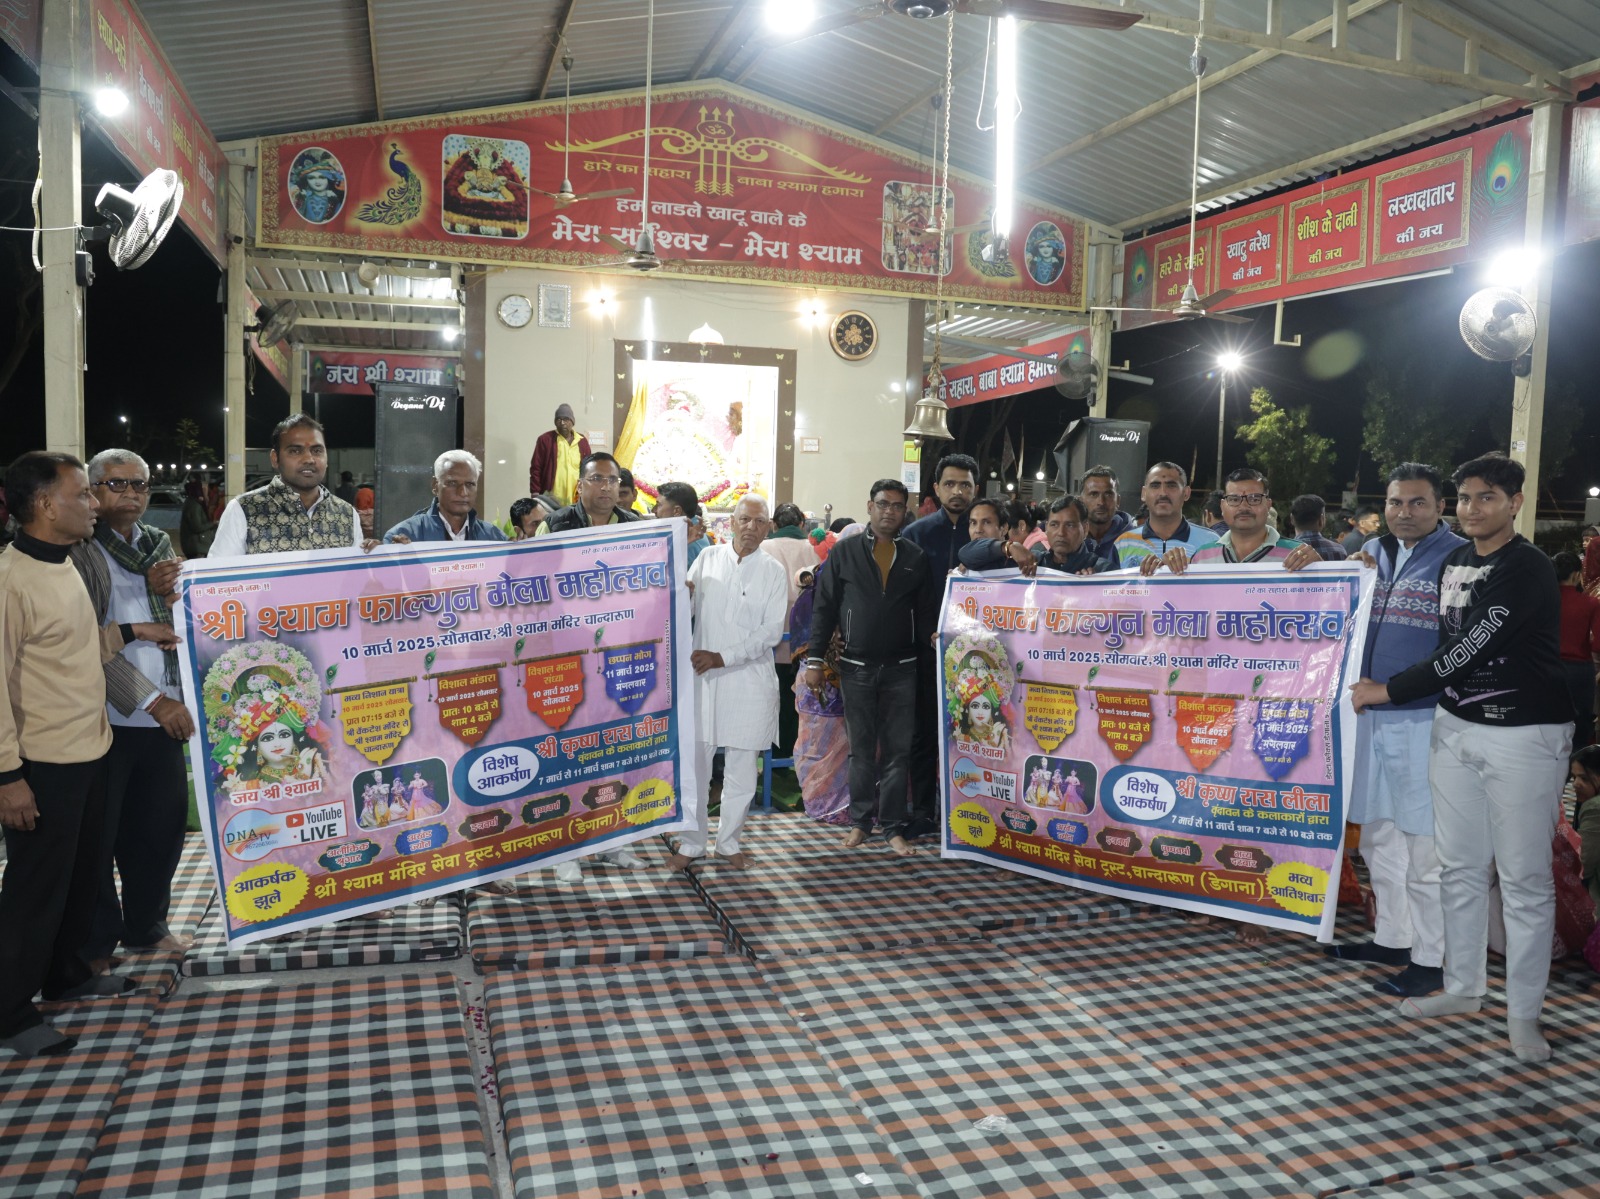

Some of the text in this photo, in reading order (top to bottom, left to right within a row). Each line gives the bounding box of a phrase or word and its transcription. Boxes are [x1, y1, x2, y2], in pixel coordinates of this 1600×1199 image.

[584, 160, 612, 172] हारे
[616, 163, 638, 175] का
[737, 176, 773, 188] बाबा
[777, 180, 818, 194] श्याम
[821, 184, 864, 198] हमारा
[1388, 181, 1456, 217] लखदातार
[616, 198, 807, 228] हम लाडले खाटू वाले के
[1297, 202, 1358, 240] शीश के दानी
[551, 215, 601, 243] मेरा
[745, 232, 789, 260] मेरा
[799, 242, 864, 265] श्याम
[1249, 230, 1271, 252] नरेश
[1396, 223, 1443, 243] की जय
[1174, 253, 1182, 272] के
[1308, 247, 1342, 264] की जय
[1232, 265, 1262, 280] की जय
[326, 360, 443, 386] जय श्री श्याम
[979, 369, 998, 391] बाबा
[999, 361, 1025, 386] श्याम
[425, 395, 446, 411] Dj
[1126, 430, 1140, 444] Dj
[461, 563, 477, 571] श्याम
[207, 585, 216, 595] श्री
[198, 560, 667, 640] श्री श्याम फाल्गुन मेला महोत्सव
[342, 648, 358, 659] 10
[363, 639, 392, 656] मार्च
[495, 623, 512, 638] श्री
[516, 621, 548, 636] श्याम
[551, 615, 580, 630] मंदिर
[584, 609, 635, 625] चान्दारूण
[982, 604, 1040, 632] श्याम
[1045, 607, 1144, 648] फाल्गुन
[1151, 601, 1209, 639] मेला
[1215, 601, 1346, 641] महोत्सव
[634, 649, 652, 660] भोग
[1028, 649, 1040, 660] 10
[1043, 648, 1065, 661] मार्च
[1153, 652, 1167, 667] श्री
[1171, 655, 1203, 668] श्याम
[1207, 653, 1238, 669] मंदिर
[528, 661, 578, 676] विशाल भजन
[606, 662, 655, 678] 11 मार्च 2025
[439, 674, 496, 690] विशाल भंडारा
[533, 684, 579, 699] 10 मार्च 2025
[442, 699, 498, 719] प्रातः 10 बजे से
[542, 695, 570, 706] सोमवार
[361, 713, 382, 723] 07:15
[384, 710, 397, 718] बजे
[399, 708, 405, 717] से
[451, 717, 468, 727] शाम
[478, 711, 492, 722] बजे
[535, 716, 669, 761] श्री कृष्ण रास लीला
[606, 745, 615, 755] के
[958, 742, 1003, 758] जय श्री श्याम
[483, 753, 519, 772] विशेष
[538, 754, 647, 786] 7 मार्च से 11 मार्च शाम 7 बजे से 10
[477, 766, 531, 791] आकर्षण
[992, 773, 1015, 787] YouTube
[1127, 777, 1159, 795] विशेष
[232, 780, 320, 804] जय श्री श्याम
[638, 787, 655, 800] भव्य
[991, 787, 1011, 800] LIVE
[1176, 775, 1330, 812] श्री कृष्ण रास लीला
[624, 797, 671, 818] आतिशबाजी
[1120, 795, 1167, 813] आकर्षण
[305, 807, 342, 824] YouTube
[226, 829, 257, 843] DNA
[300, 823, 337, 842] LIVE
[314, 877, 337, 899] श्री
[343, 871, 384, 891] श्याम
[389, 861, 427, 880] मंदिर
[431, 851, 460, 872] सेवा
[501, 827, 563, 853] चान्दारूण
[1000, 833, 1012, 850] श्री
[1015, 840, 1041, 857] श्याम
[1044, 844, 1070, 864] मंदिर
[1073, 850, 1097, 869] सेवा
[1131, 865, 1195, 887] चान्दारूण
[234, 869, 297, 894] आकर्षक
[253, 889, 282, 909] झूले
